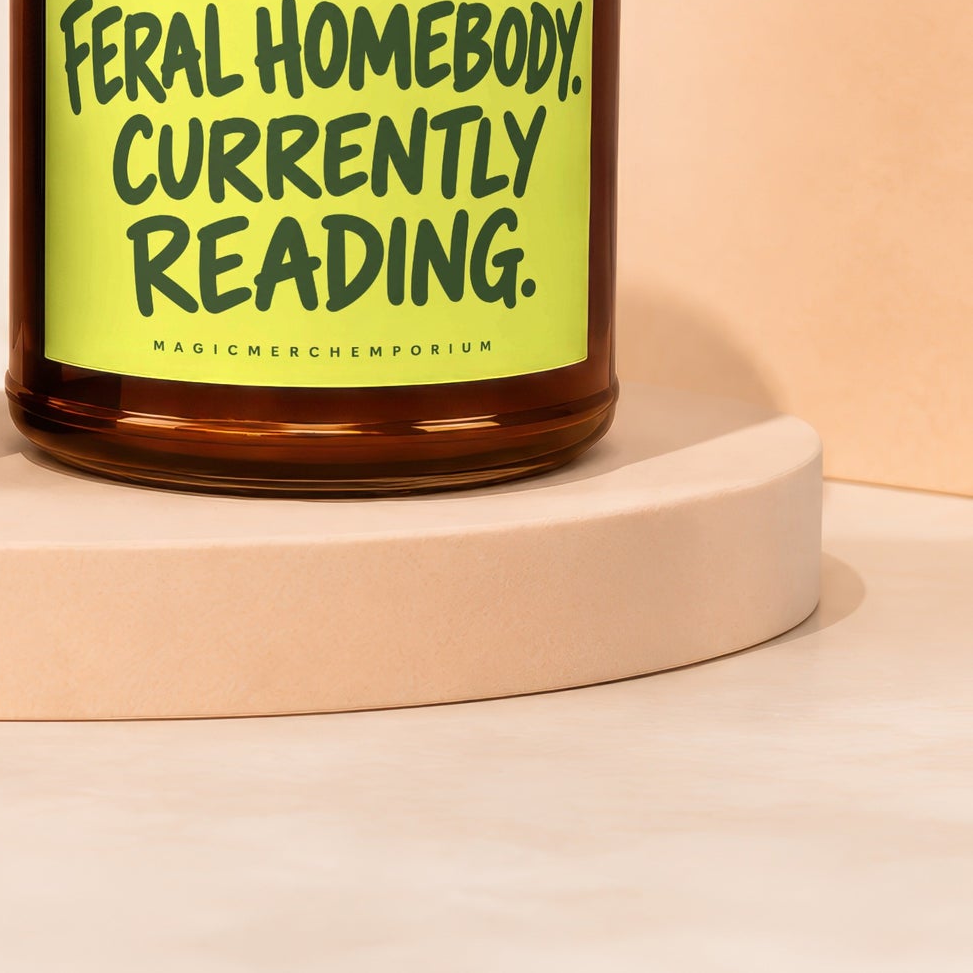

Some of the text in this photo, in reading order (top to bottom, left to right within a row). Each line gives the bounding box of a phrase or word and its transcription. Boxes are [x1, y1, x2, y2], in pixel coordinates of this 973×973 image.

[112, 104, 547, 206] CURRENTLY
[126, 207, 537, 318] READING.
[153, 339, 493, 358] MAGICMERCHEMPORIUM
